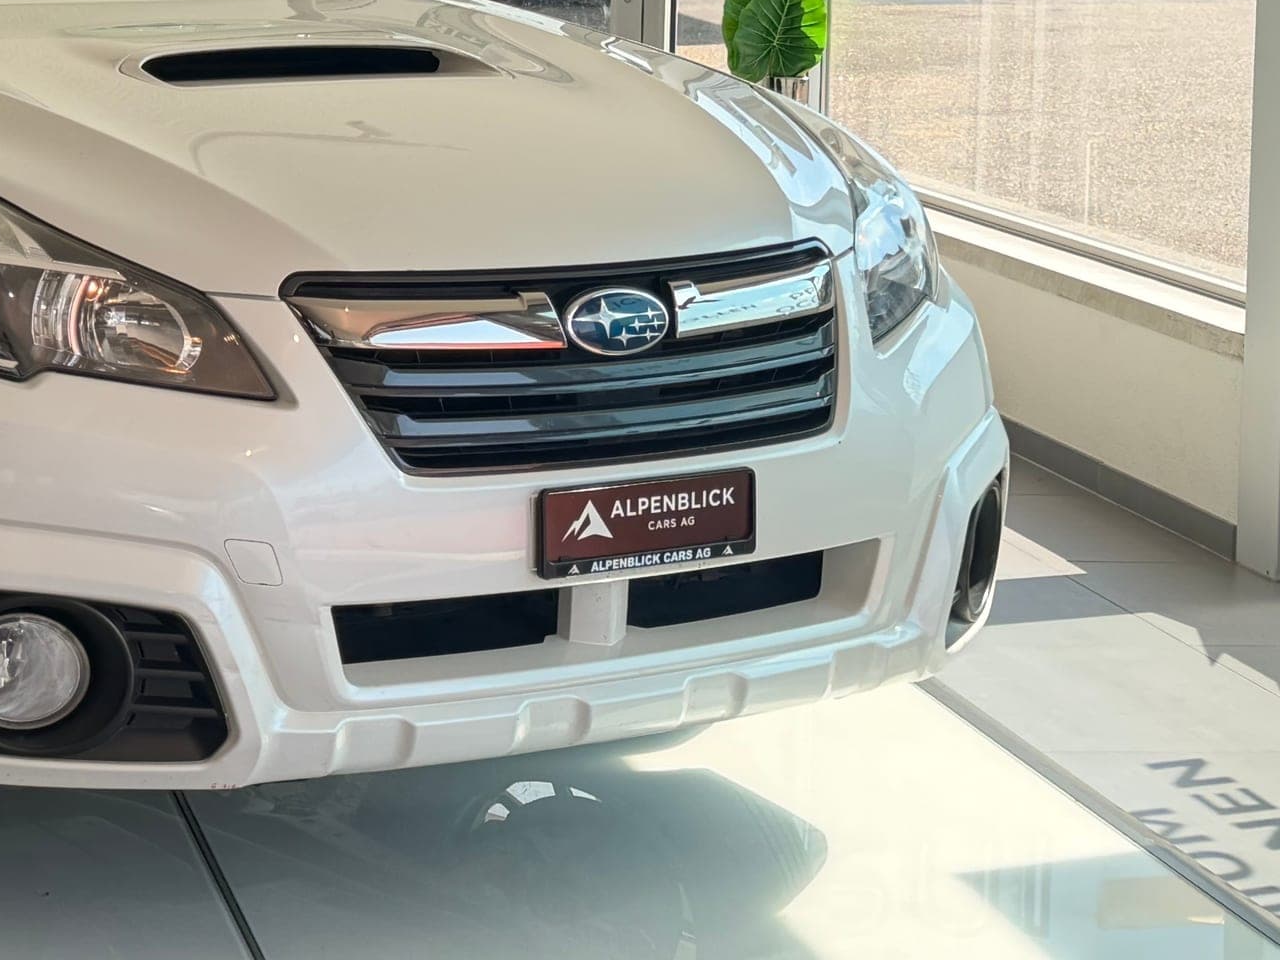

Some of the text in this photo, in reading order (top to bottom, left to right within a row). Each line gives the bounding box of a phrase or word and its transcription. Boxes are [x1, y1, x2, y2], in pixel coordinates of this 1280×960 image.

[610, 487, 735, 518] ALPENBLICK
[647, 515, 696, 531] CARS AG
[590, 547, 712, 572] ALPENBLICK CARS AG
